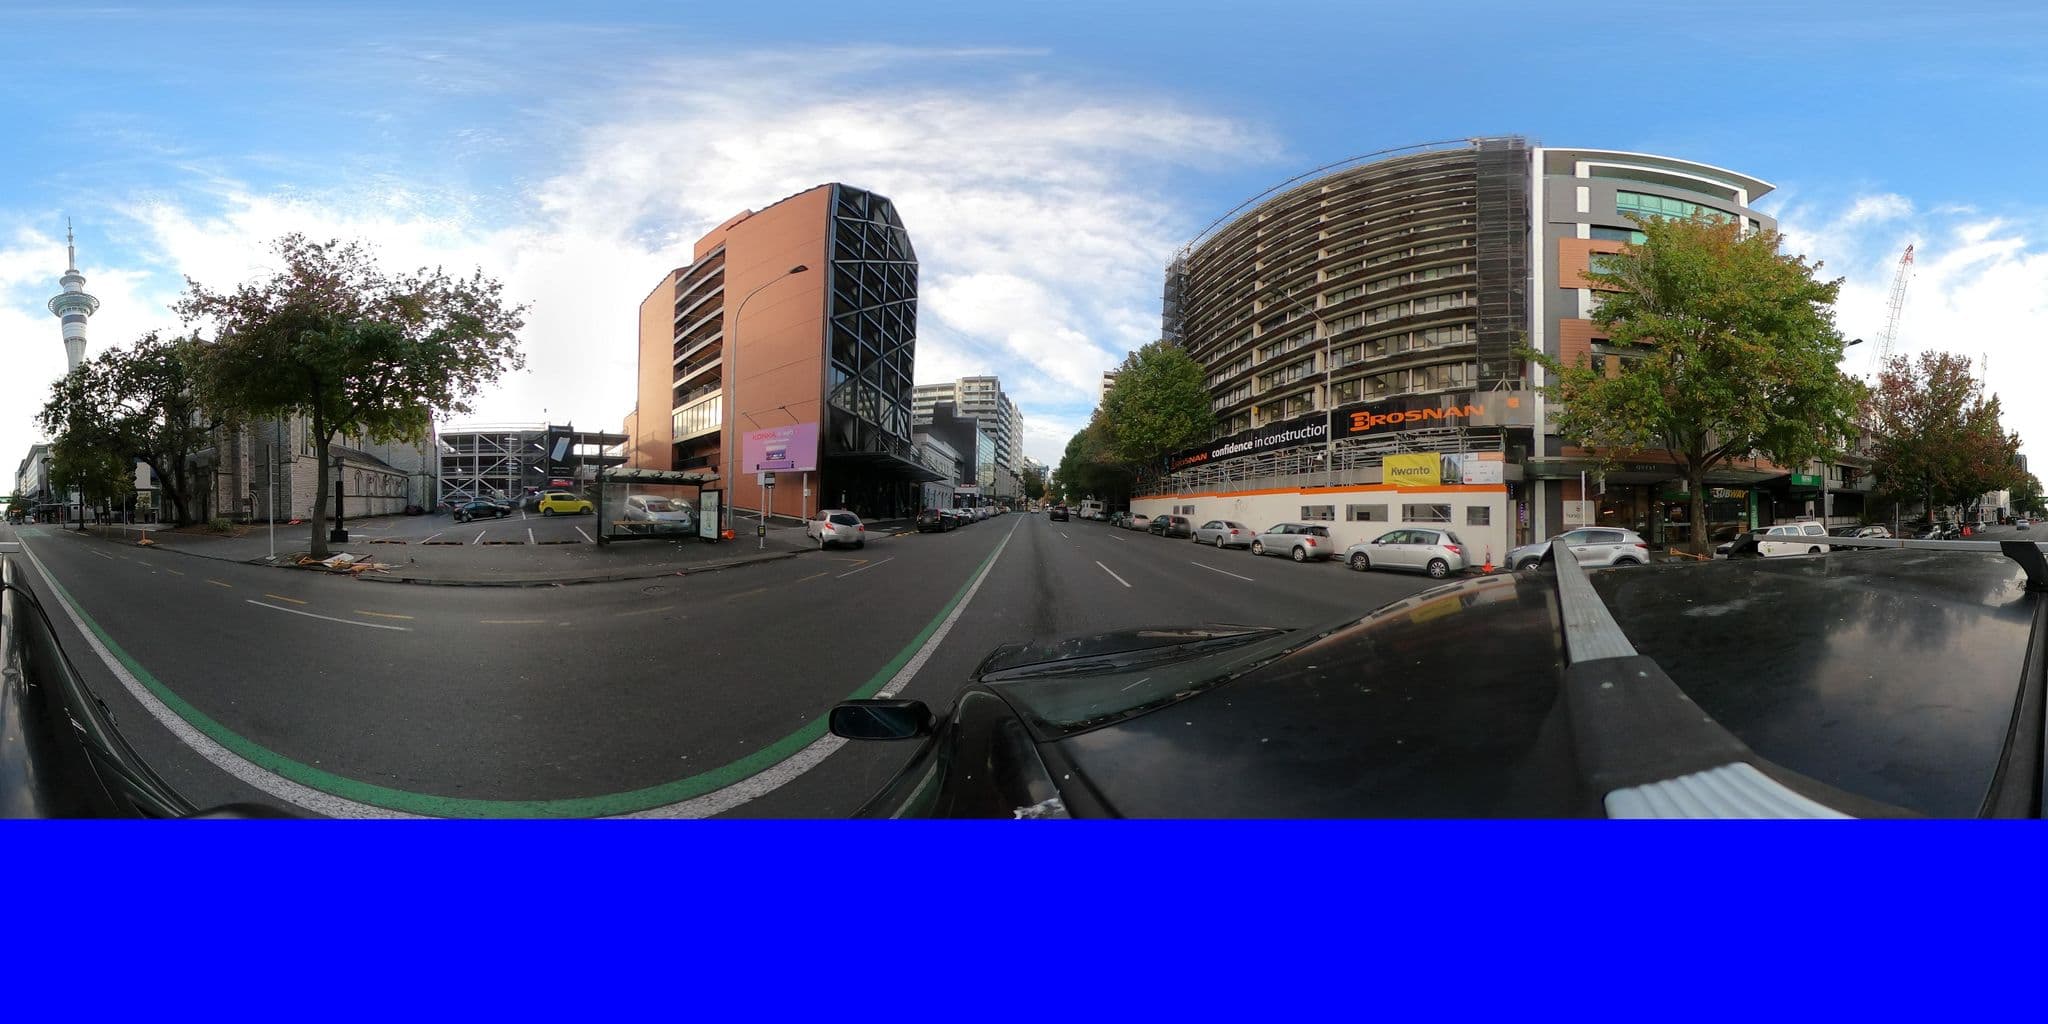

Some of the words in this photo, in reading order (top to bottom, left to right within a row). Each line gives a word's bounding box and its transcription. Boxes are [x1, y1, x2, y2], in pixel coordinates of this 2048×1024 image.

[1350, 405, 1485, 432] BROSNAN
[1211, 441, 1253, 458] confidence
[1254, 436, 1263, 448] in
[1391, 466, 1430, 476] Kwanto
[1712, 487, 1748, 499] SUBWAY
